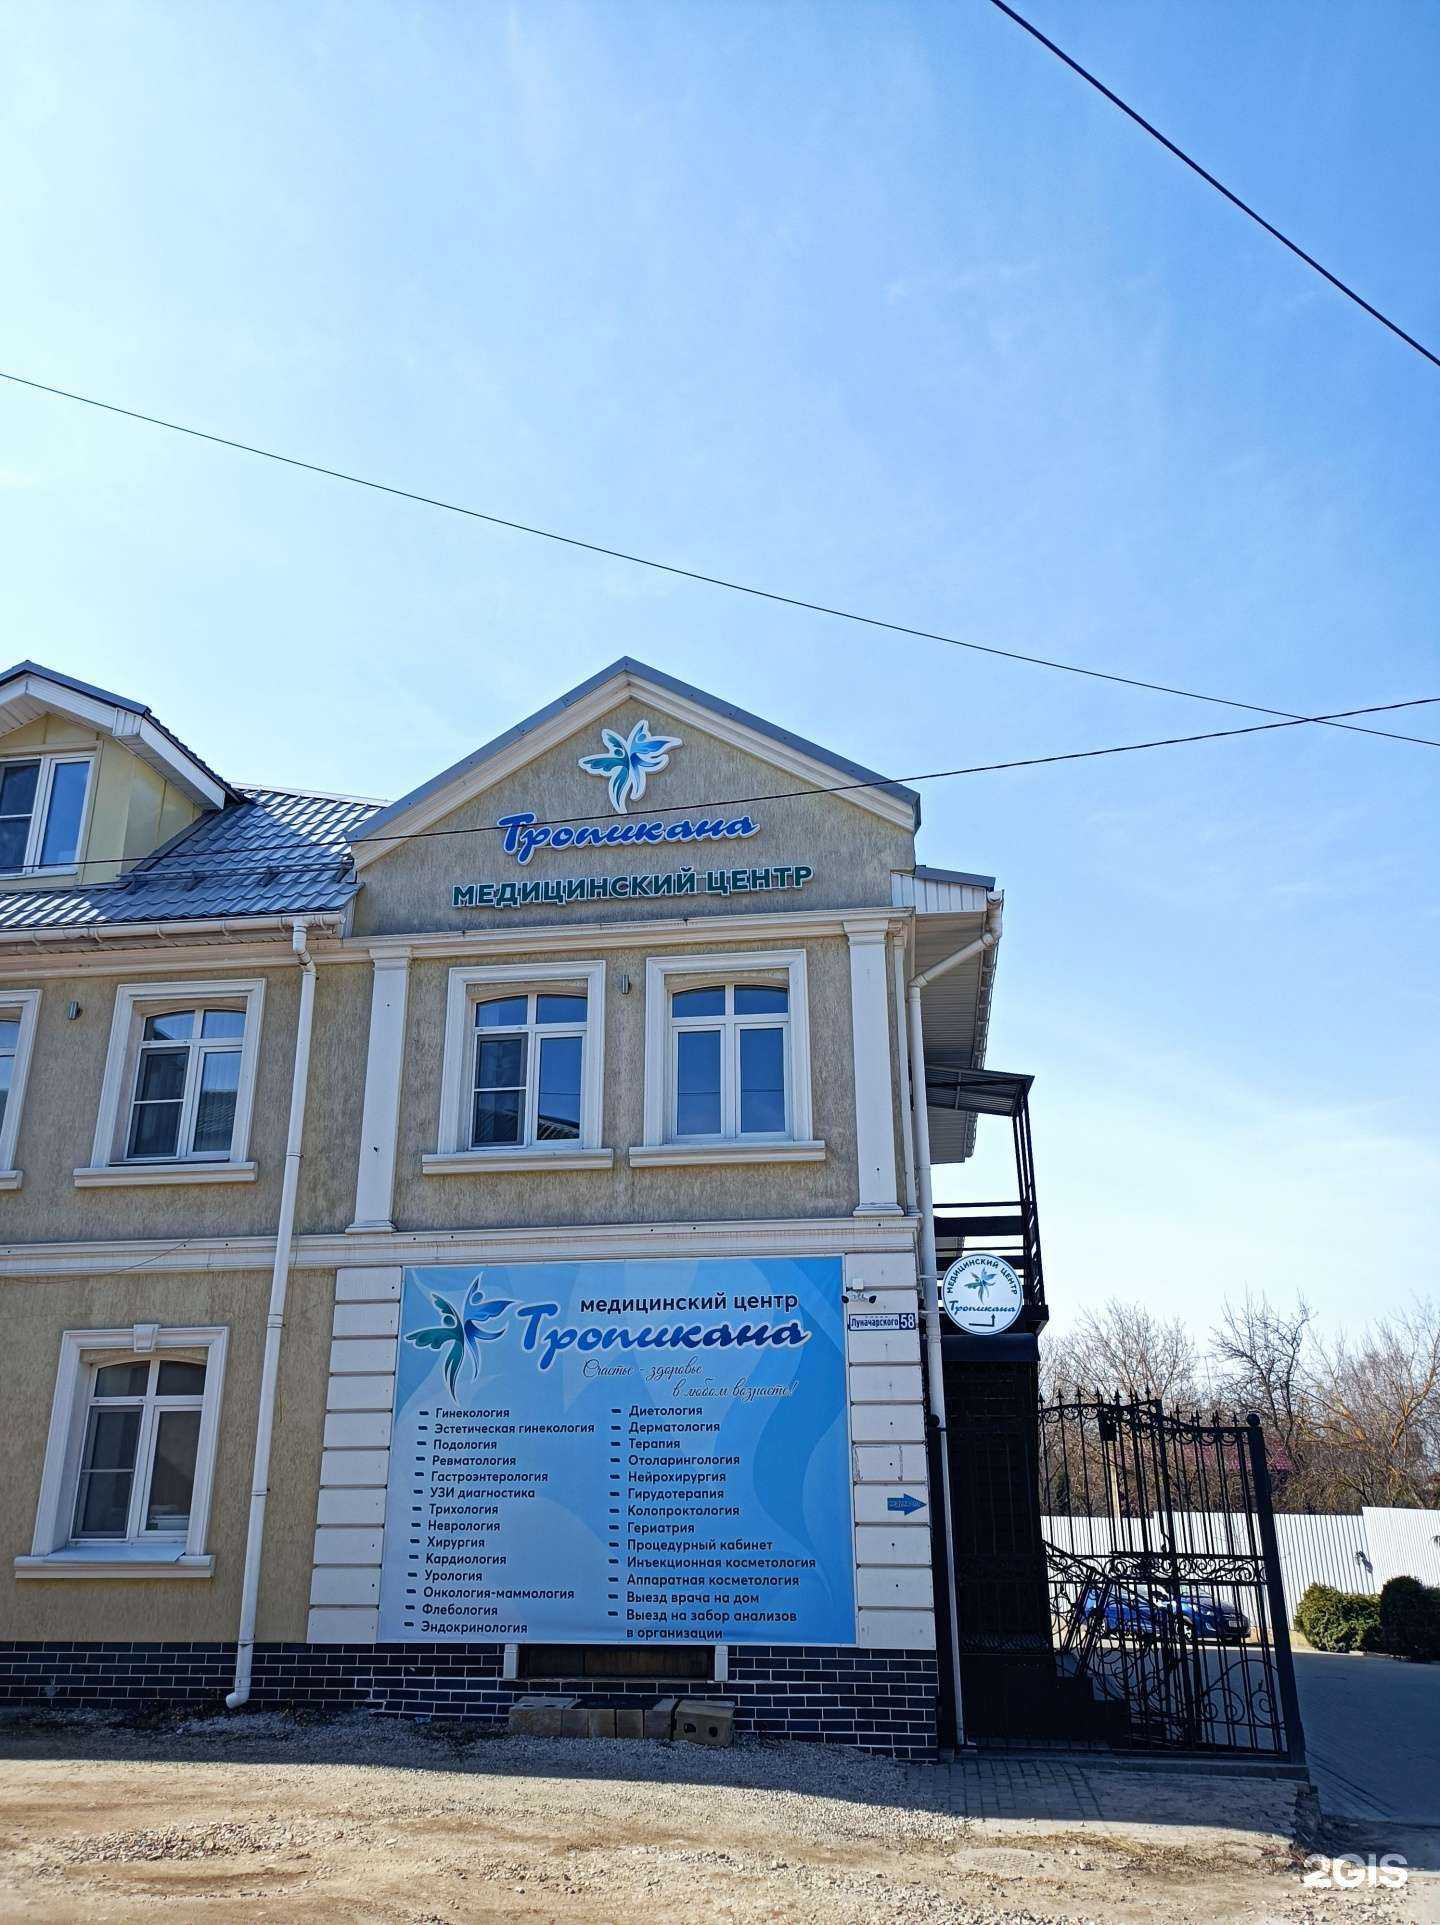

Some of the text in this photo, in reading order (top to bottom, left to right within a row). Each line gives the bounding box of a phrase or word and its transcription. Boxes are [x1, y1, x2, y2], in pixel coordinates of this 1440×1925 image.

[498, 812, 760, 865] Тропикана
[452, 866, 813, 908] МЕДИЦИНСКИЙ ЦЕНТР
[947, 1259, 1017, 1294] МЕДИЦИНСКИЙ ЦЕНТР
[580, 1291, 798, 1313] медицинский центр
[949, 1300, 1016, 1315] Тропикана
[852, 1315, 914, 1328] Луначарского 58
[516, 1301, 810, 1370] Тропикана
[583, 1359, 632, 1377] Счастье
[646, 1356, 703, 1381] здоровье
[673, 1377, 799, 1401] в любом возрасте!
[435, 1407, 510, 1419] Гинекология
[629, 1405, 703, 1418] Диетология
[434, 1422, 595, 1435] Эстетическая гинекология
[629, 1421, 720, 1433] Дерматология
[433, 1439, 497, 1451] Подология
[629, 1438, 680, 1451] Терапия
[432, 1454, 516, 1468] Ревматология
[628, 1454, 740, 1467] Отоларингология
[431, 1471, 548, 1484] Гастроэнтерология
[628, 1470, 726, 1484] Нейрохирургия
[430, 1487, 535, 1500] УЗИ диагностика
[628, 1488, 724, 1501] Гирудотерапия
[429, 1504, 498, 1516] Трихология
[627, 1505, 740, 1518] Колопроктология
[428, 1520, 501, 1532] Неврология
[627, 1522, 695, 1535] Гериатрия
[426, 1537, 485, 1550] Хирургия
[627, 1537, 773, 1553] Процедурный кабинет
[425, 1553, 507, 1566] Кардиология
[627, 1556, 816, 1569] Инъекционная косметология
[425, 1570, 482, 1583] Урология
[627, 1574, 800, 1587] Аппаратная косметология
[423, 1587, 575, 1601] Онкология-маммология
[627, 1591, 759, 1605] Выезд врача на дом
[422, 1604, 498, 1616] Флебология
[626, 1609, 797, 1622] Выезд на забор анализов
[420, 1621, 528, 1634] Эндокринология
[626, 1628, 723, 1640] в организации
